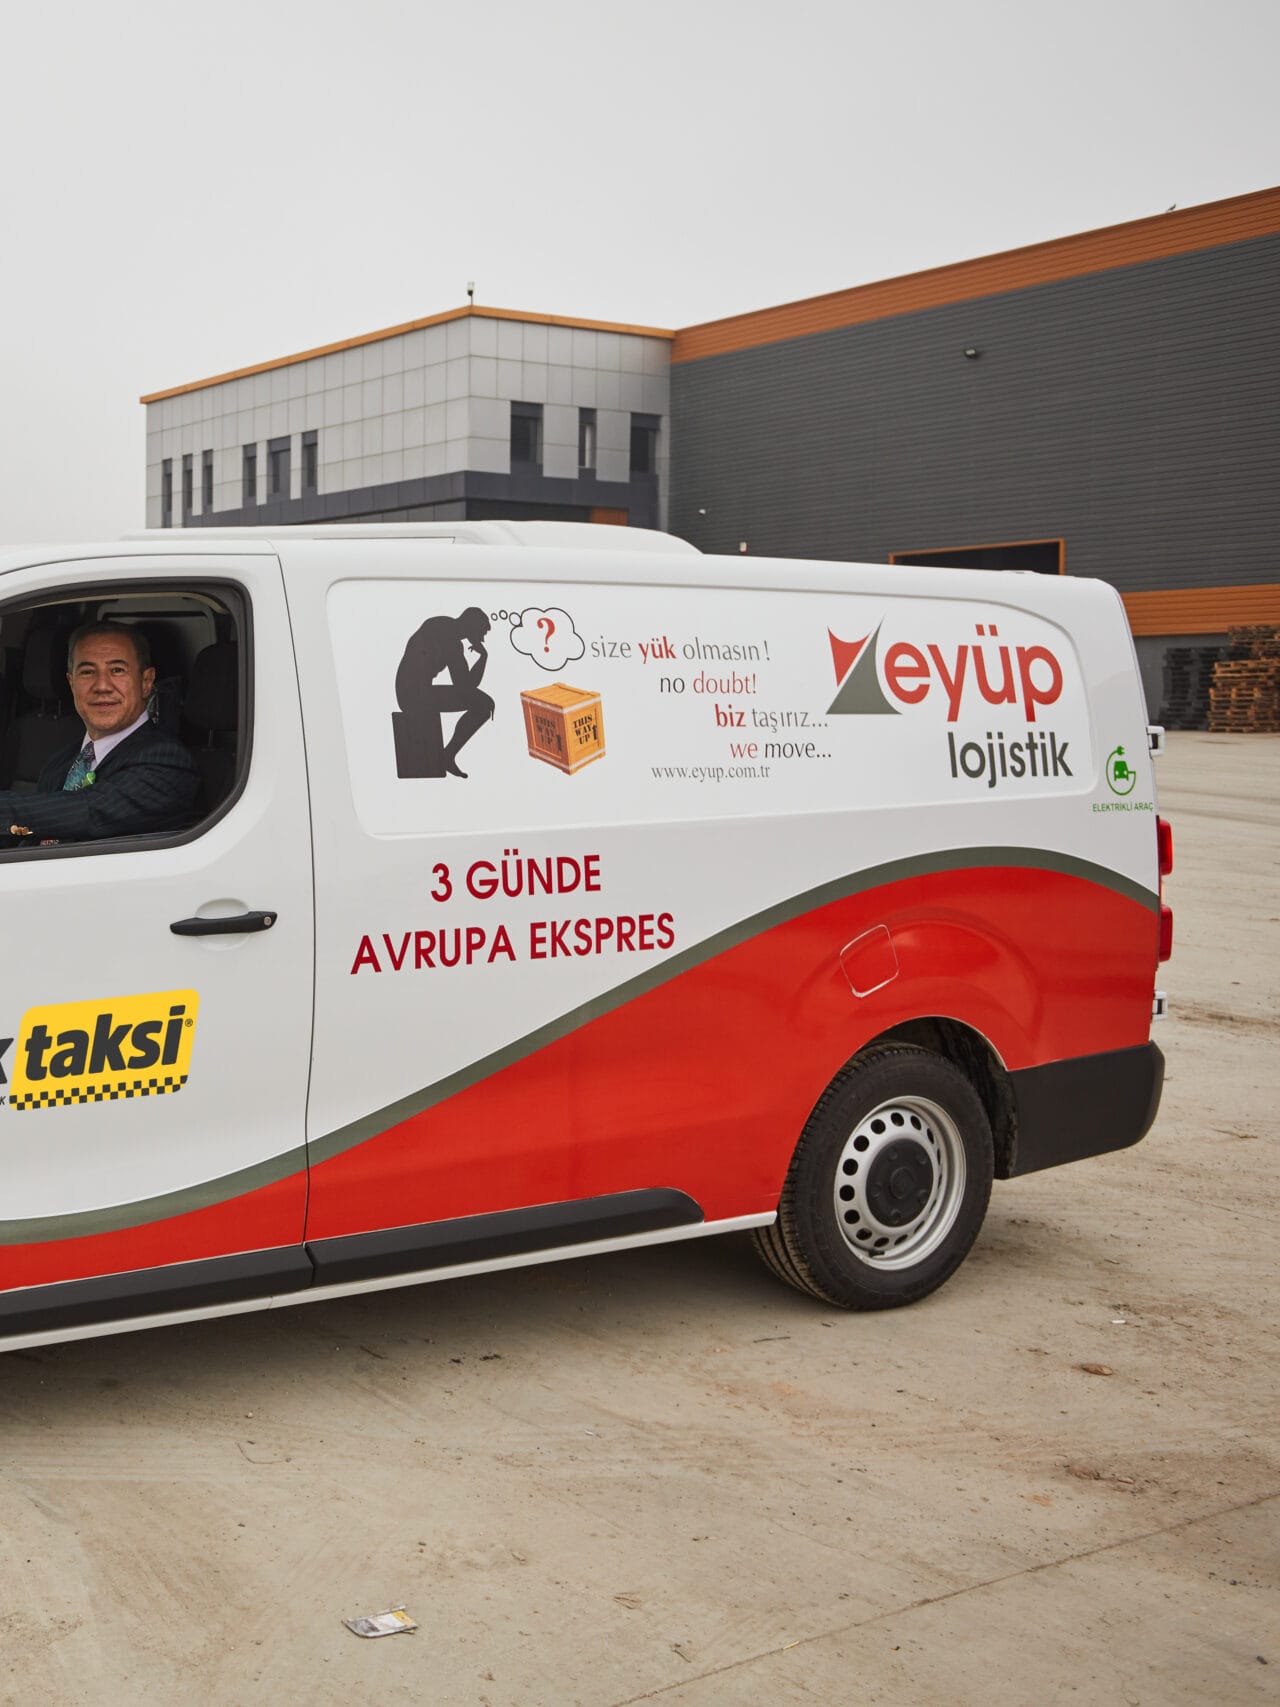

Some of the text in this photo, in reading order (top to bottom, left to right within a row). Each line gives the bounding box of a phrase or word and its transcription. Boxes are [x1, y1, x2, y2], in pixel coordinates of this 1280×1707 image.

[590, 635, 632, 659] size
[638, 635, 677, 665] yük
[660, 670, 758, 695] no doubt!
[884, 624, 1063, 722] eyüp
[573, 715, 593, 729] THIS
[714, 703, 747, 728] biz
[579, 734, 591, 745] UP
[730, 741, 833, 759] we move...
[650, 764, 772, 783] www.eyup.com.tr
[946, 731, 1074, 789] lojistik
[431, 848, 601, 902] 3 GÜNDE
[350, 912, 675, 975] AVRUPA EKSPRES
[24, 1004, 186, 1081] taksi
